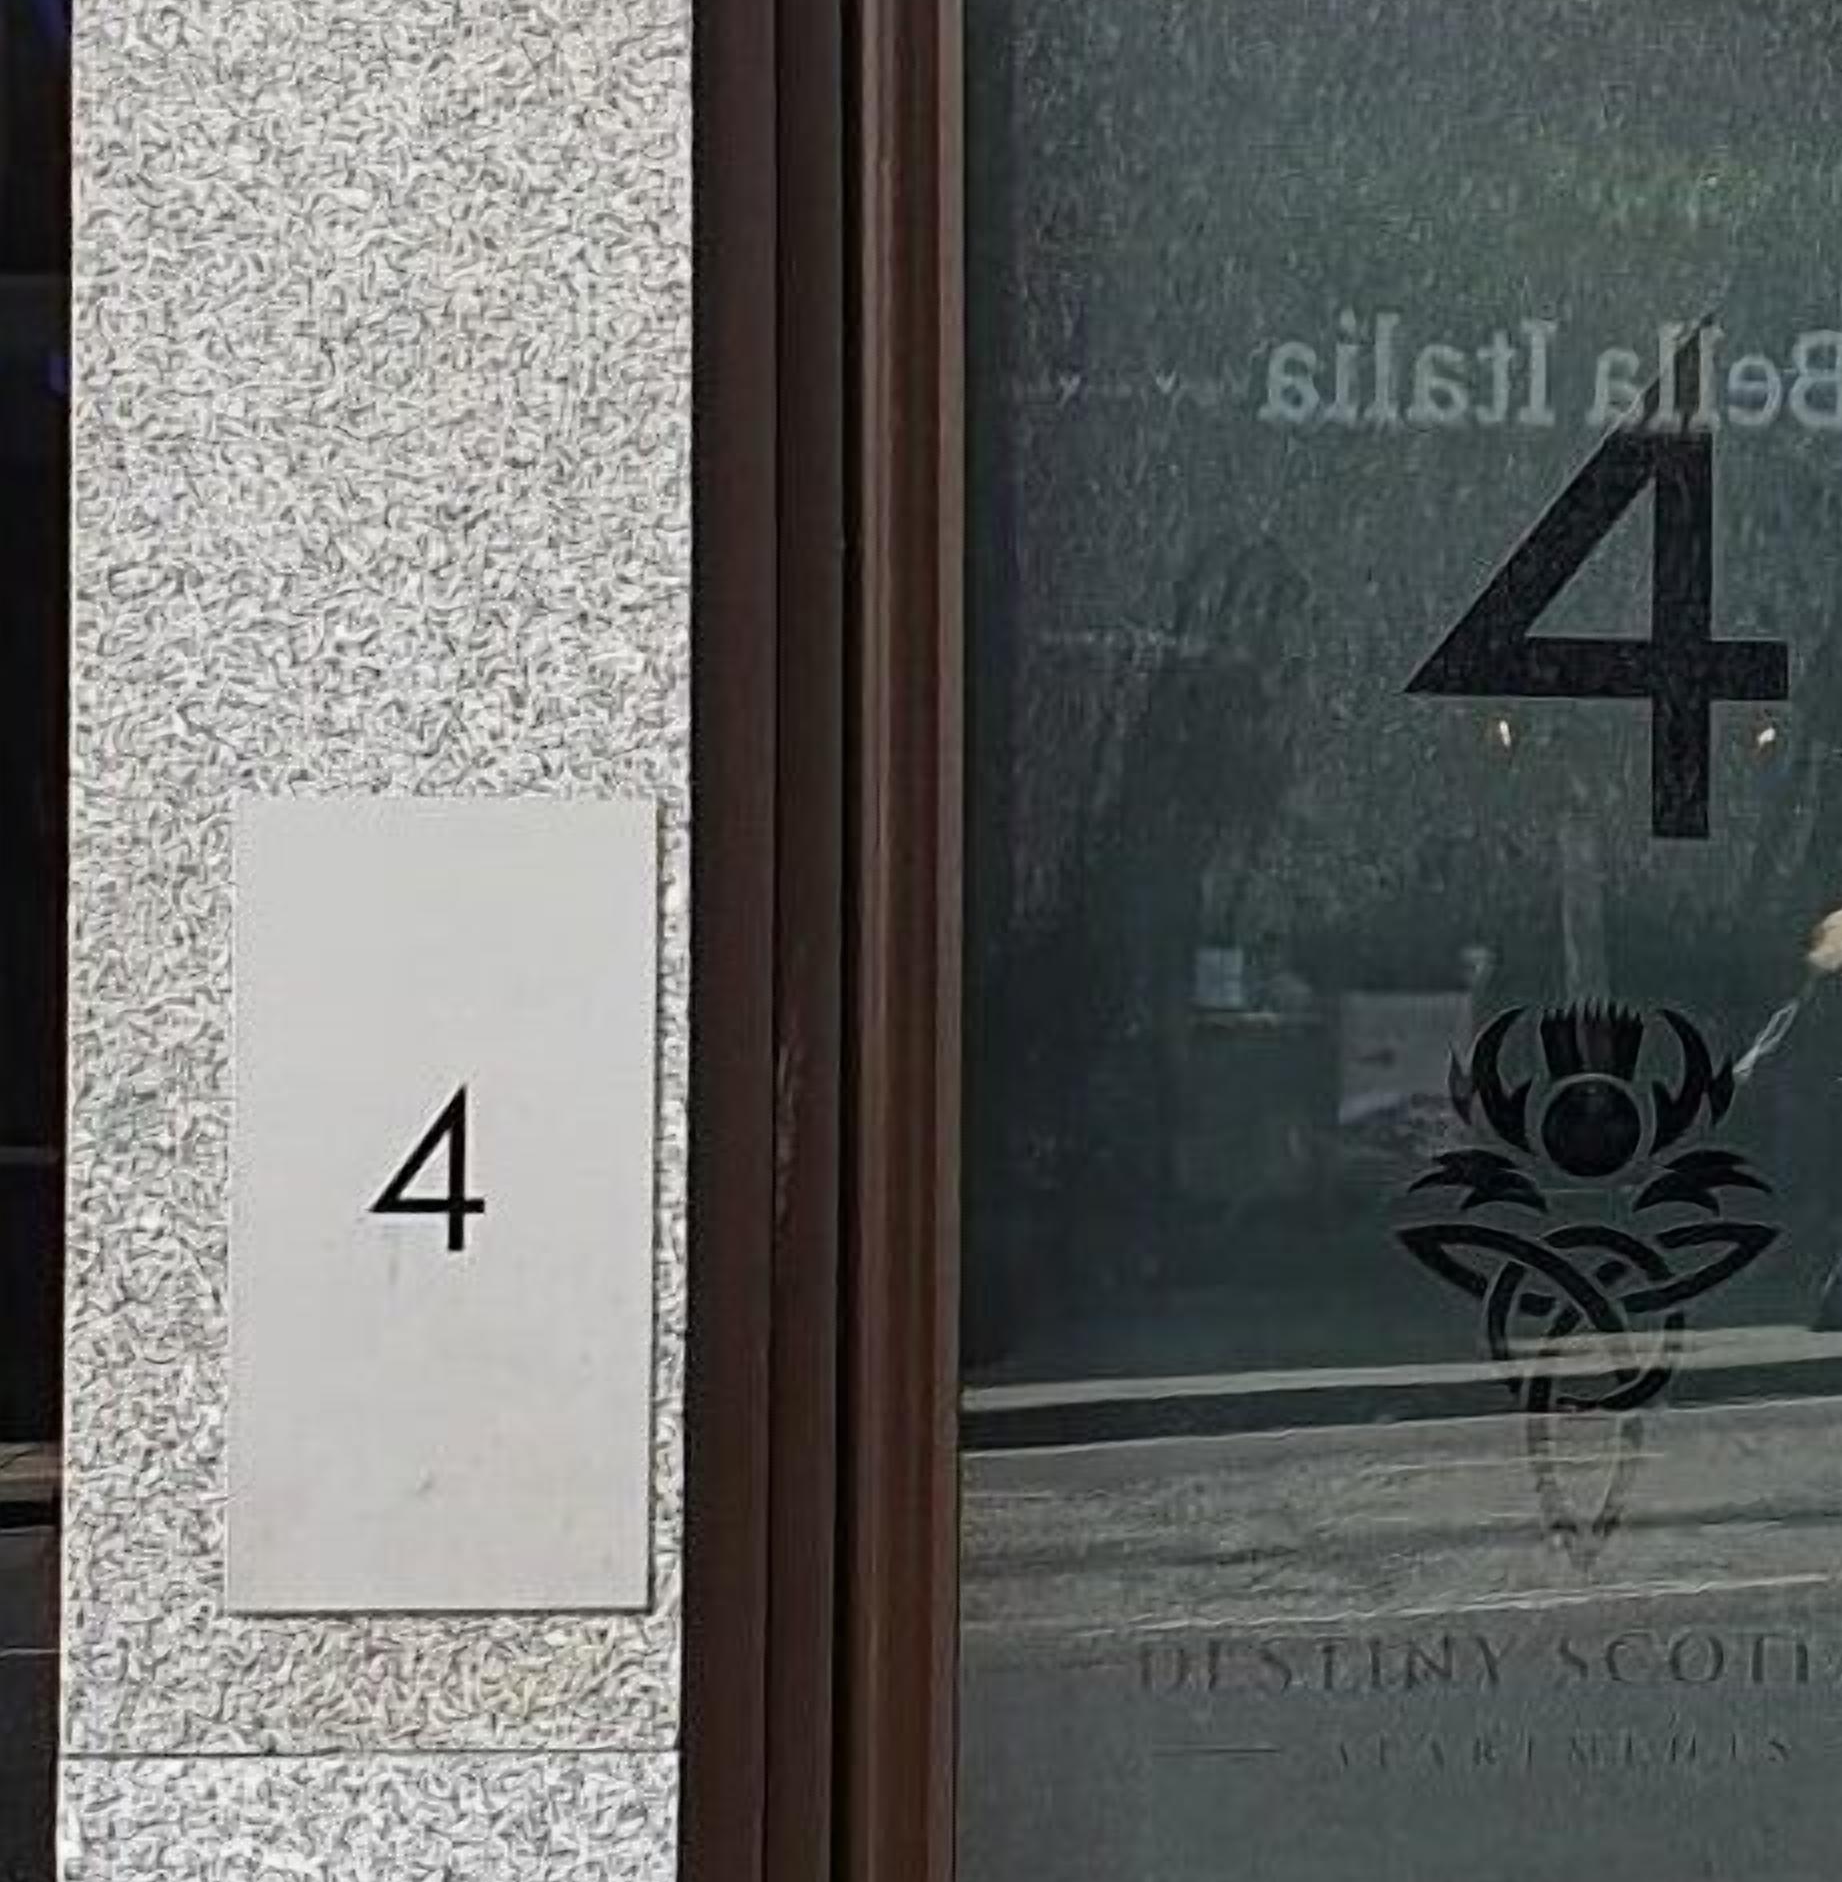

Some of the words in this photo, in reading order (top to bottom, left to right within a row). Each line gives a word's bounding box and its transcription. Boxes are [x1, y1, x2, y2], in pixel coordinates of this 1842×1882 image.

[1401, 305, 1789, 839] 4
[368, 1082, 485, 1252] 4
[1138, 1634, 1516, 1690] DESTINY
